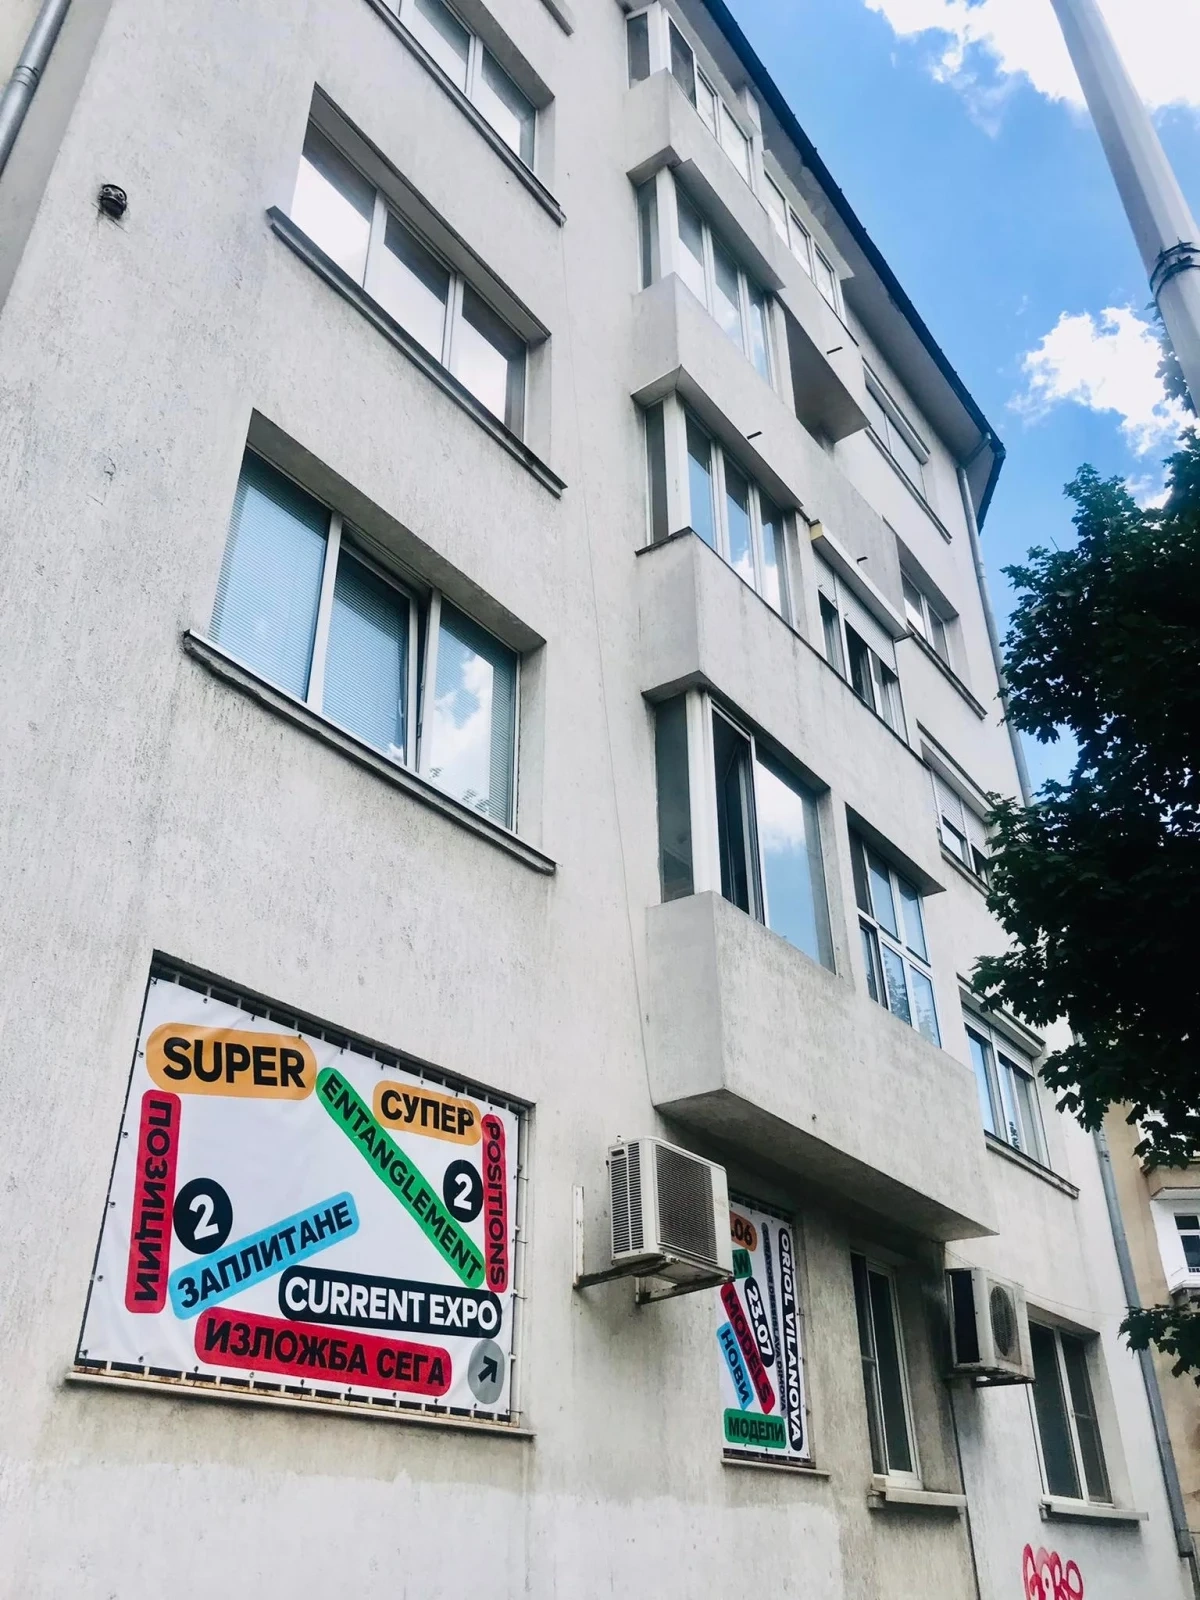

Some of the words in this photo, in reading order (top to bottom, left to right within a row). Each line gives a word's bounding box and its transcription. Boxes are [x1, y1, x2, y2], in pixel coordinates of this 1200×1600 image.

[162, 1037, 307, 1089] SUPER
[380, 1089, 475, 1136] СУПЕР
[133, 1100, 172, 1302] ПОЗИЦИИ
[321, 1073, 483, 1281] ENTANGLEMENT
[453, 1172, 473, 1210] 2
[486, 1122, 506, 1286] POSITIONS
[188, 1194, 219, 1241] 2
[177, 1200, 353, 1309] ЗАПЛИТАНЕ
[780, 1233, 795, 1311] ORIOL
[284, 1277, 425, 1323] CURRENT
[428, 1292, 499, 1330] EXPO
[746, 1285, 773, 1358] 23.07
[204, 1316, 368, 1376] ИЗЛОЖБА
[375, 1348, 445, 1387] СЕГА
[722, 1328, 750, 1404] НОВИ
[725, 1291, 770, 1405] MODELS
[783, 1314, 801, 1443] VILANOVA
[777, 1361, 786, 1411] DIMOVA
[727, 1415, 785, 1443] МОДЕЛИ
